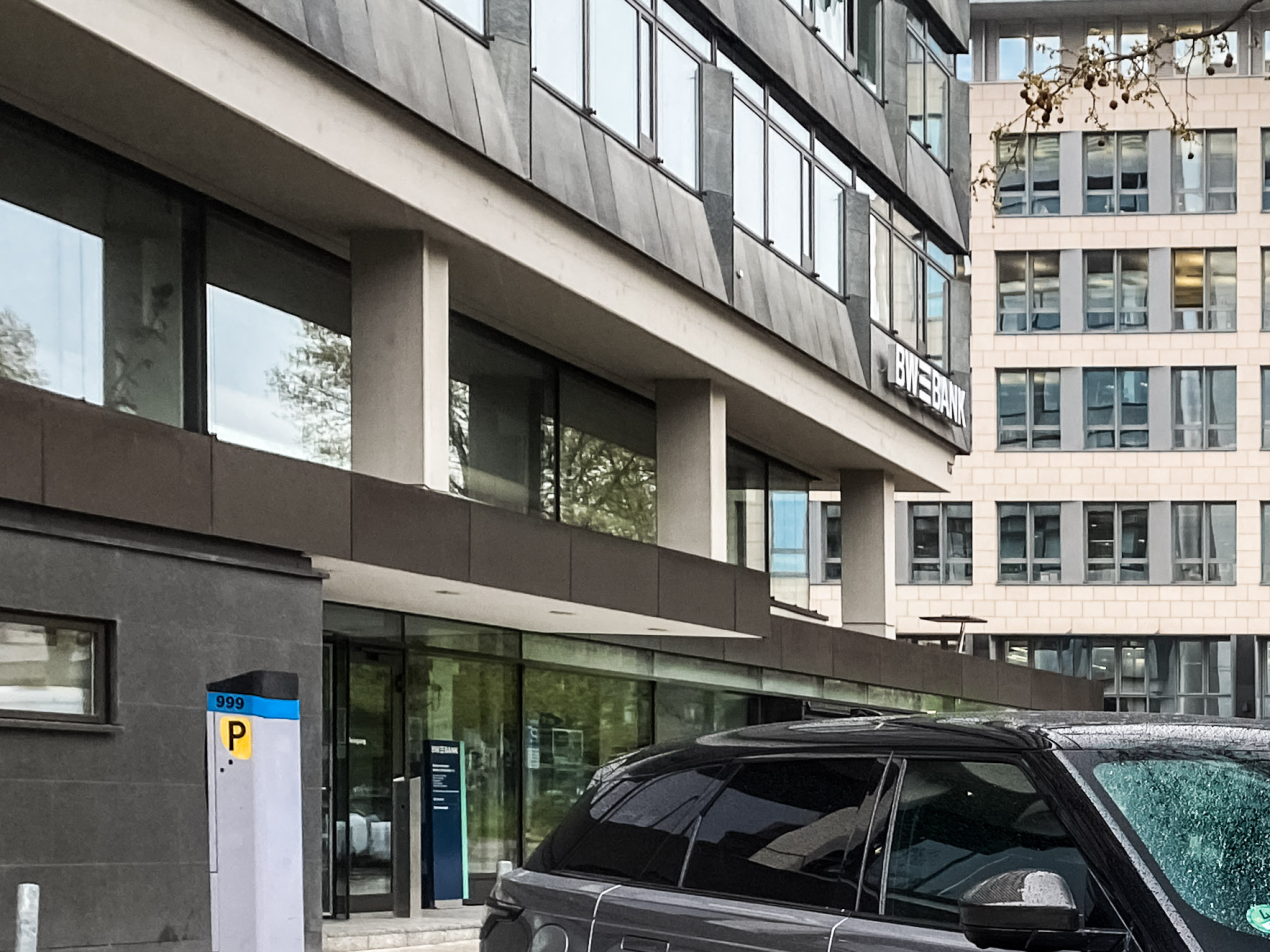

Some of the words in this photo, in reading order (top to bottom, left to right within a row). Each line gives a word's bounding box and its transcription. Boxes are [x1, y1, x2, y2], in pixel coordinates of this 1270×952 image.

[932, 368, 967, 428] BANK
[216, 695, 245, 710] 999
[228, 720, 246, 751] P
